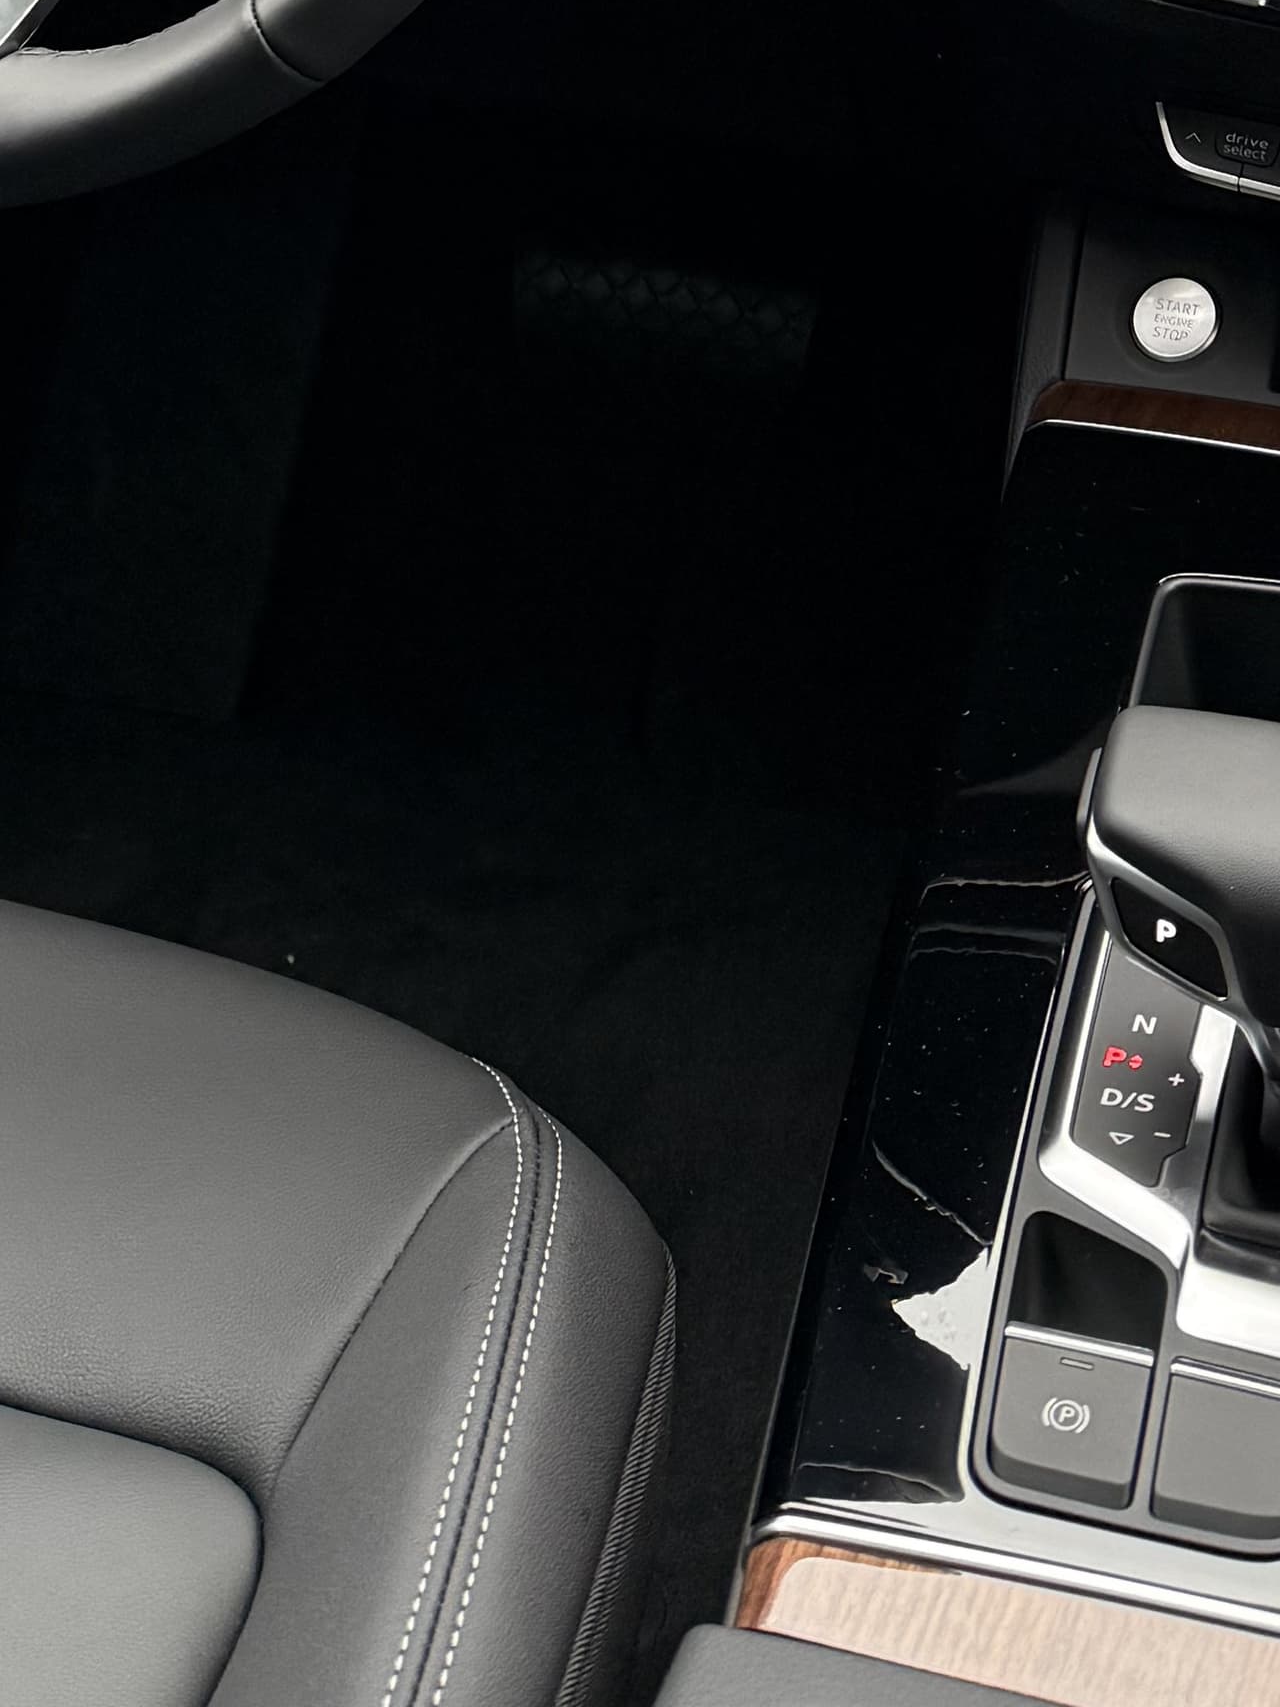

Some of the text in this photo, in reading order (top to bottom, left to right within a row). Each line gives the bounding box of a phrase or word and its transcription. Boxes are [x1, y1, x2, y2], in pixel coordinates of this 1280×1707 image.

[1225, 132, 1269, 150] drive
[1223, 142, 1267, 161] select
[1156, 298, 1200, 316] START
[1154, 313, 1194, 329] ENGINE
[1153, 326, 1189, 341] STOP
[1155, 918, 1177, 943] P
[1131, 1014, 1157, 1035] N
[1100, 1087, 1156, 1113] D/S
